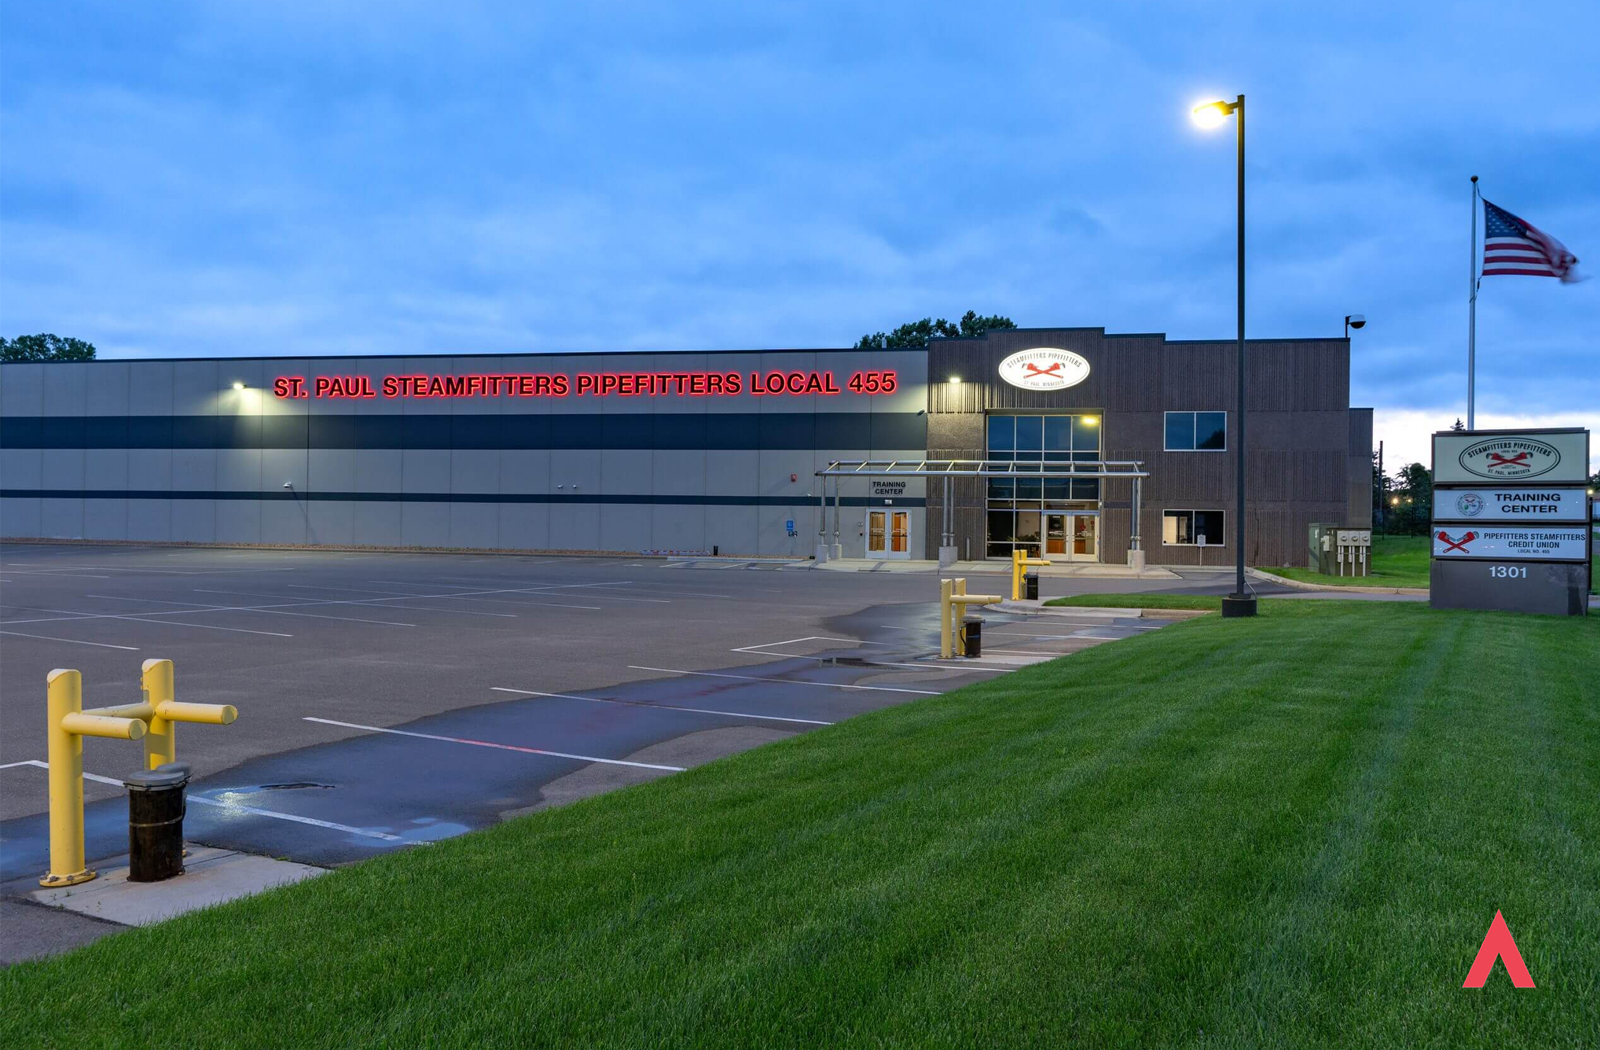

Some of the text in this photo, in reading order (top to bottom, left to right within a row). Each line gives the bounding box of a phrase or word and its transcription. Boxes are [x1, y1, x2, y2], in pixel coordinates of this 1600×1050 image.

[273, 371, 897, 398] ST. PAUL STEAMFITTERS PIPEFITTERS LOCAL 455
[1467, 442, 1552, 459] STEAMFITTERS PIPEFITTERS
[1494, 493, 1561, 502] TRAINING
[1501, 504, 1558, 513] CENTER
[1484, 532, 1586, 541] PIPEFITTERS STEAMFITTERS
[1508, 540, 1560, 549] CREDIT UNION
[1489, 565, 1527, 578] 1301
